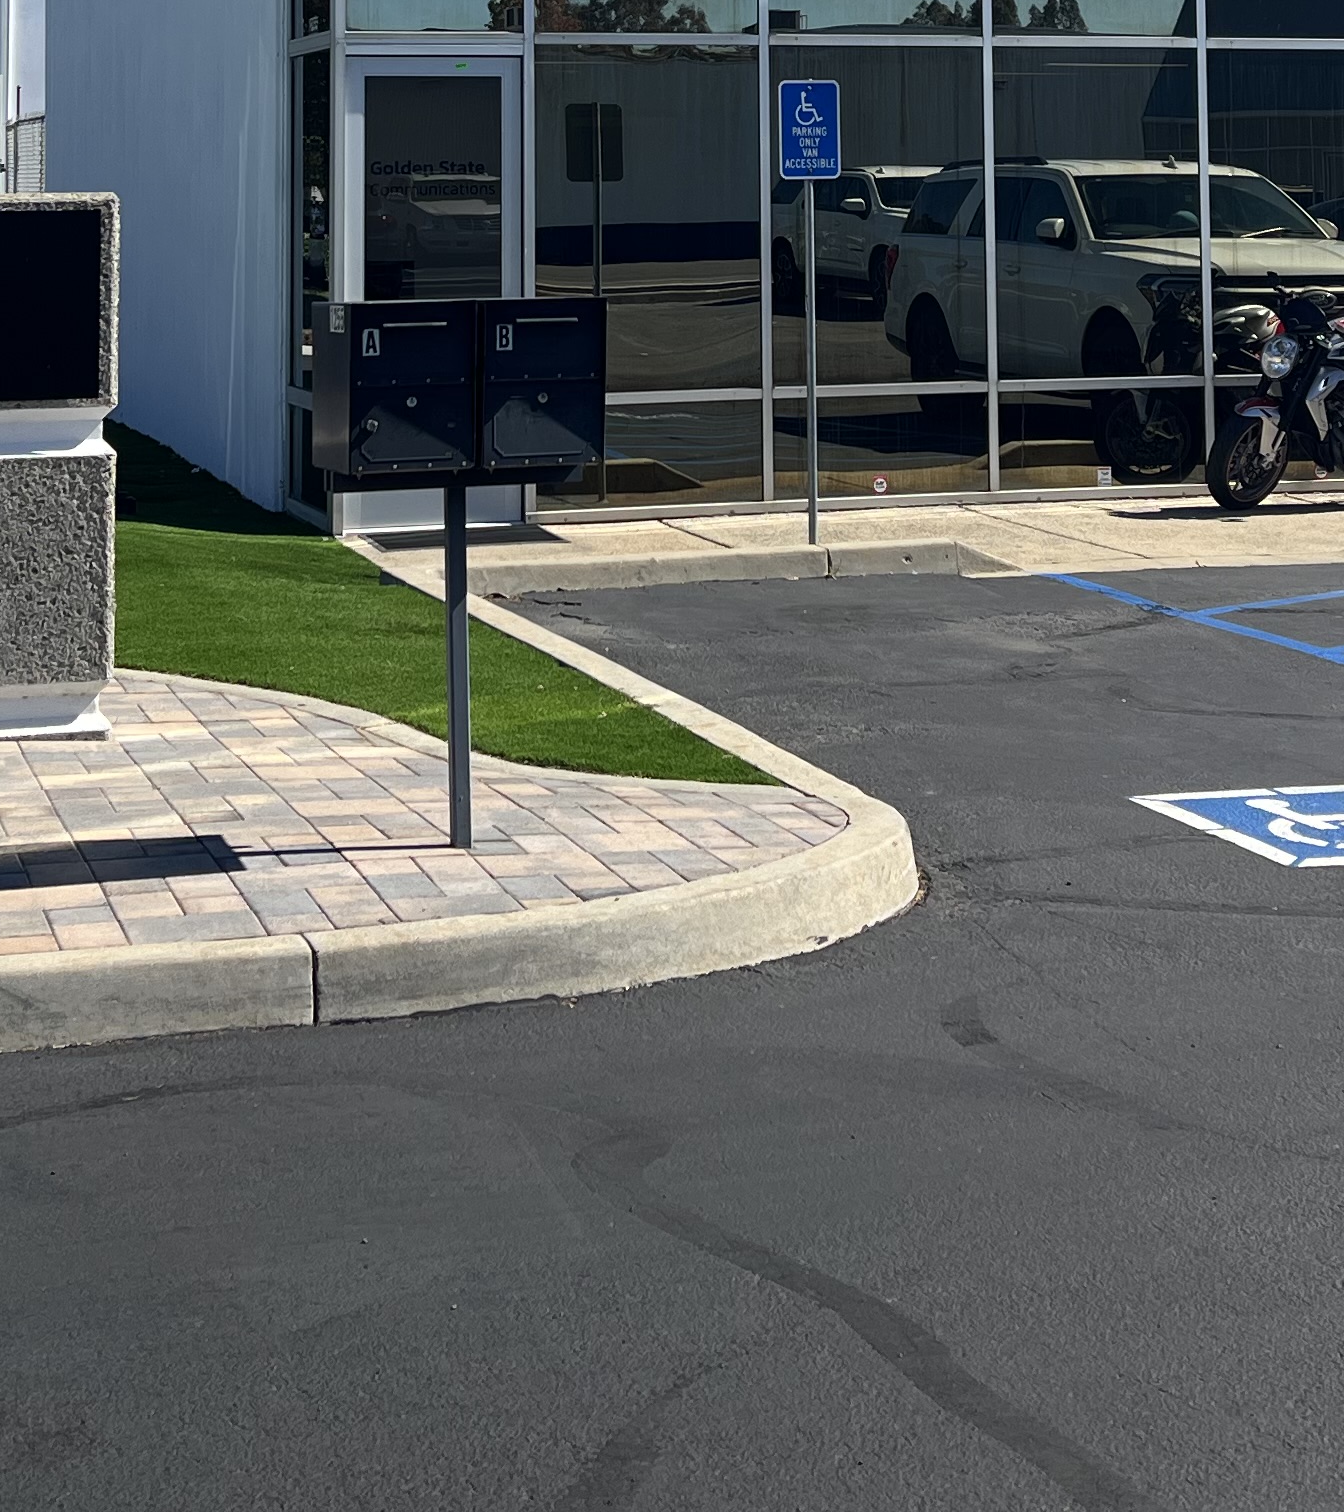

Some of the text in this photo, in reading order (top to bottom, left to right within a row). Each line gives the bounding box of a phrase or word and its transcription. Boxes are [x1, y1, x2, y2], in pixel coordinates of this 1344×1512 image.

[792, 126, 827, 137] PARKING
[799, 137, 820, 147] ONLY
[802, 148, 818, 157] VAN
[370, 159, 486, 176] Golden State
[785, 158, 836, 169] ACCESSIBLE
[370, 182, 496, 198] Communications
[365, 330, 378, 354] A
[498, 325, 510, 348] B
